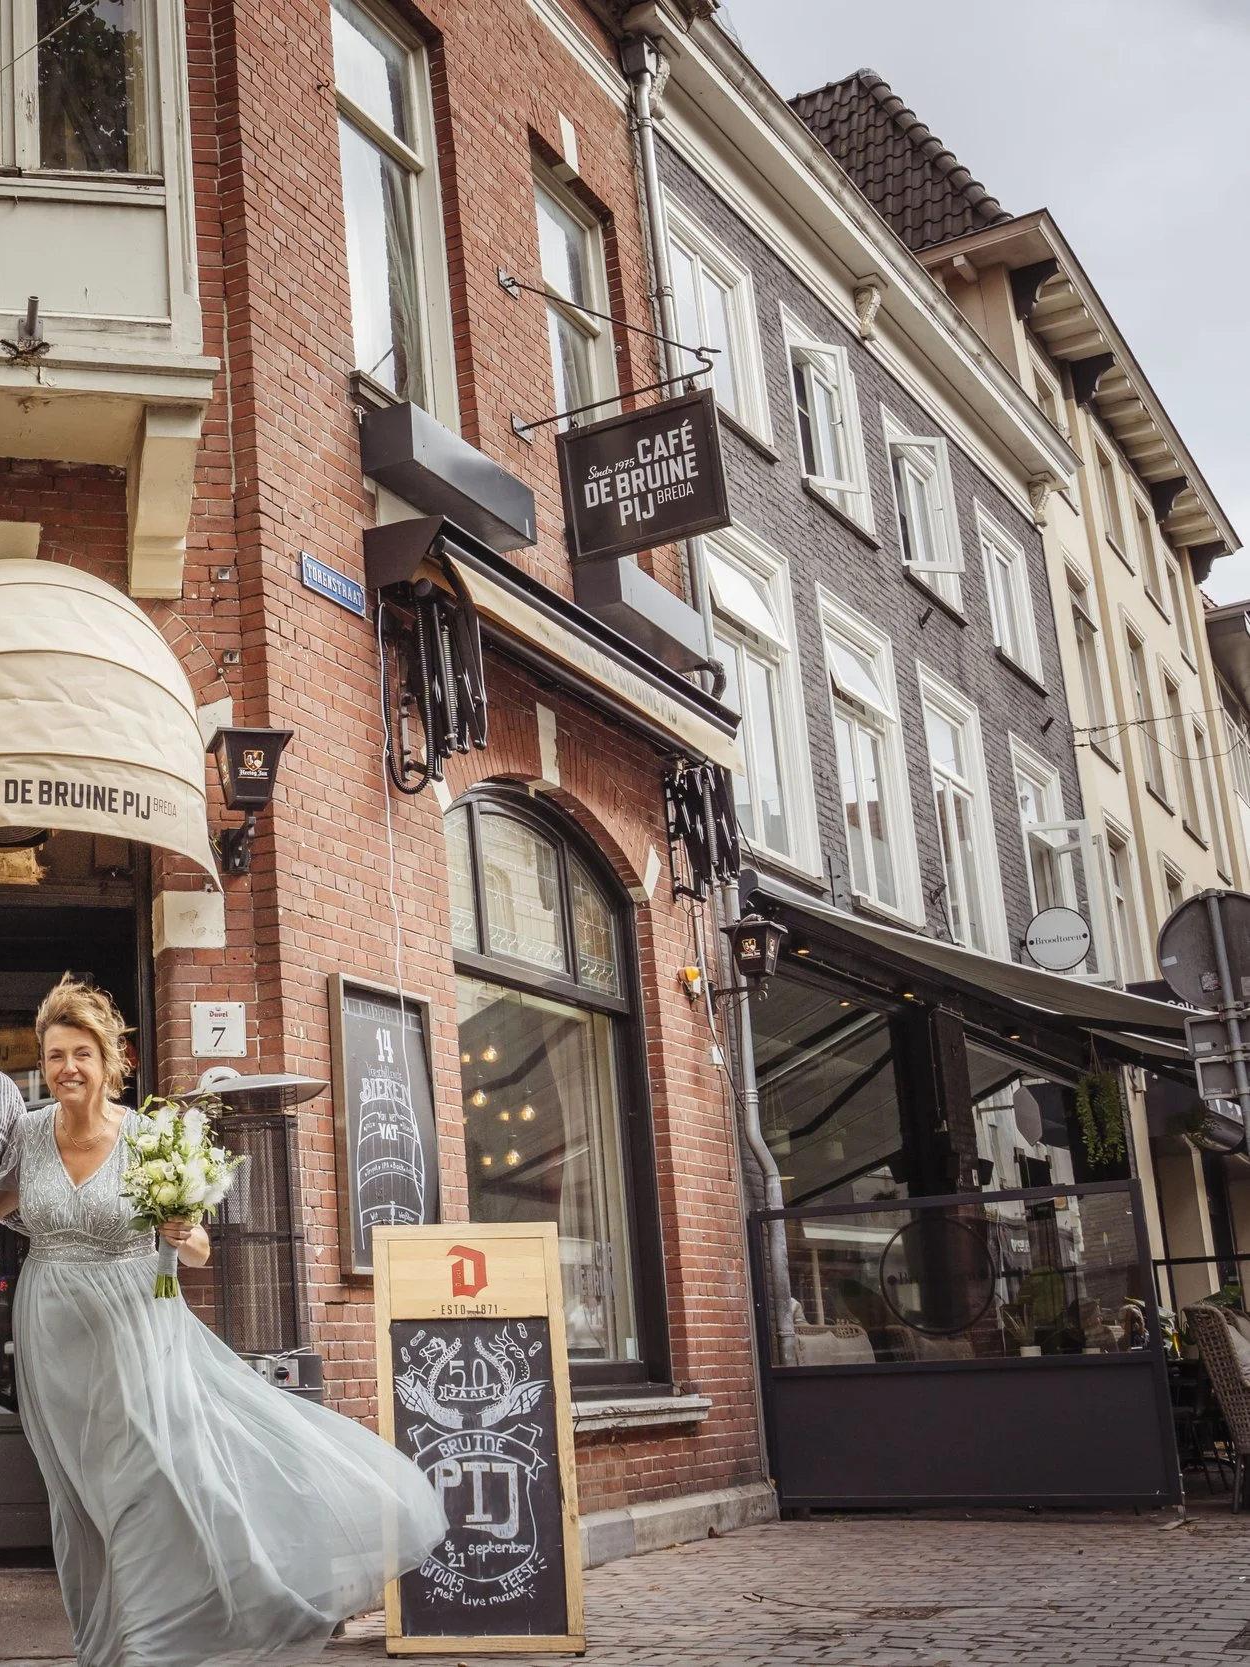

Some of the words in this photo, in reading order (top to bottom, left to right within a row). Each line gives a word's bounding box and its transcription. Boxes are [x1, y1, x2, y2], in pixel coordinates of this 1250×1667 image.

[587, 465, 613, 480] Sinds
[614, 457, 635, 473] 1975
[636, 418, 695, 464] CAFÉ
[583, 477, 613, 509] DE
[615, 451, 699, 499] BRUINE
[618, 493, 655, 526] PIJ
[656, 481, 694, 505] BREDA
[306, 562, 363, 607] TORENSTRAAT
[4, 779, 33, 804] DE
[38, 780, 119, 814] BRUINE
[123, 790, 150, 820] PIJ
[153, 797, 178, 818] BREDA
[1034, 934, 1082, 946] Broodtoren
[209, 1010, 228, 1018] Duvel
[211, 1026, 226, 1048] 7
[376, 1027, 394, 1064] 14
[378, 1122, 399, 1141] VAT
[475, 1303, 498, 1316] 1871
[449, 1358, 489, 1389] 50
[449, 1388, 488, 1399] JAAR
[434, 1459, 520, 1539] PIJ
[447, 1552, 466, 1568] 21
[468, 1541, 532, 1562] september
